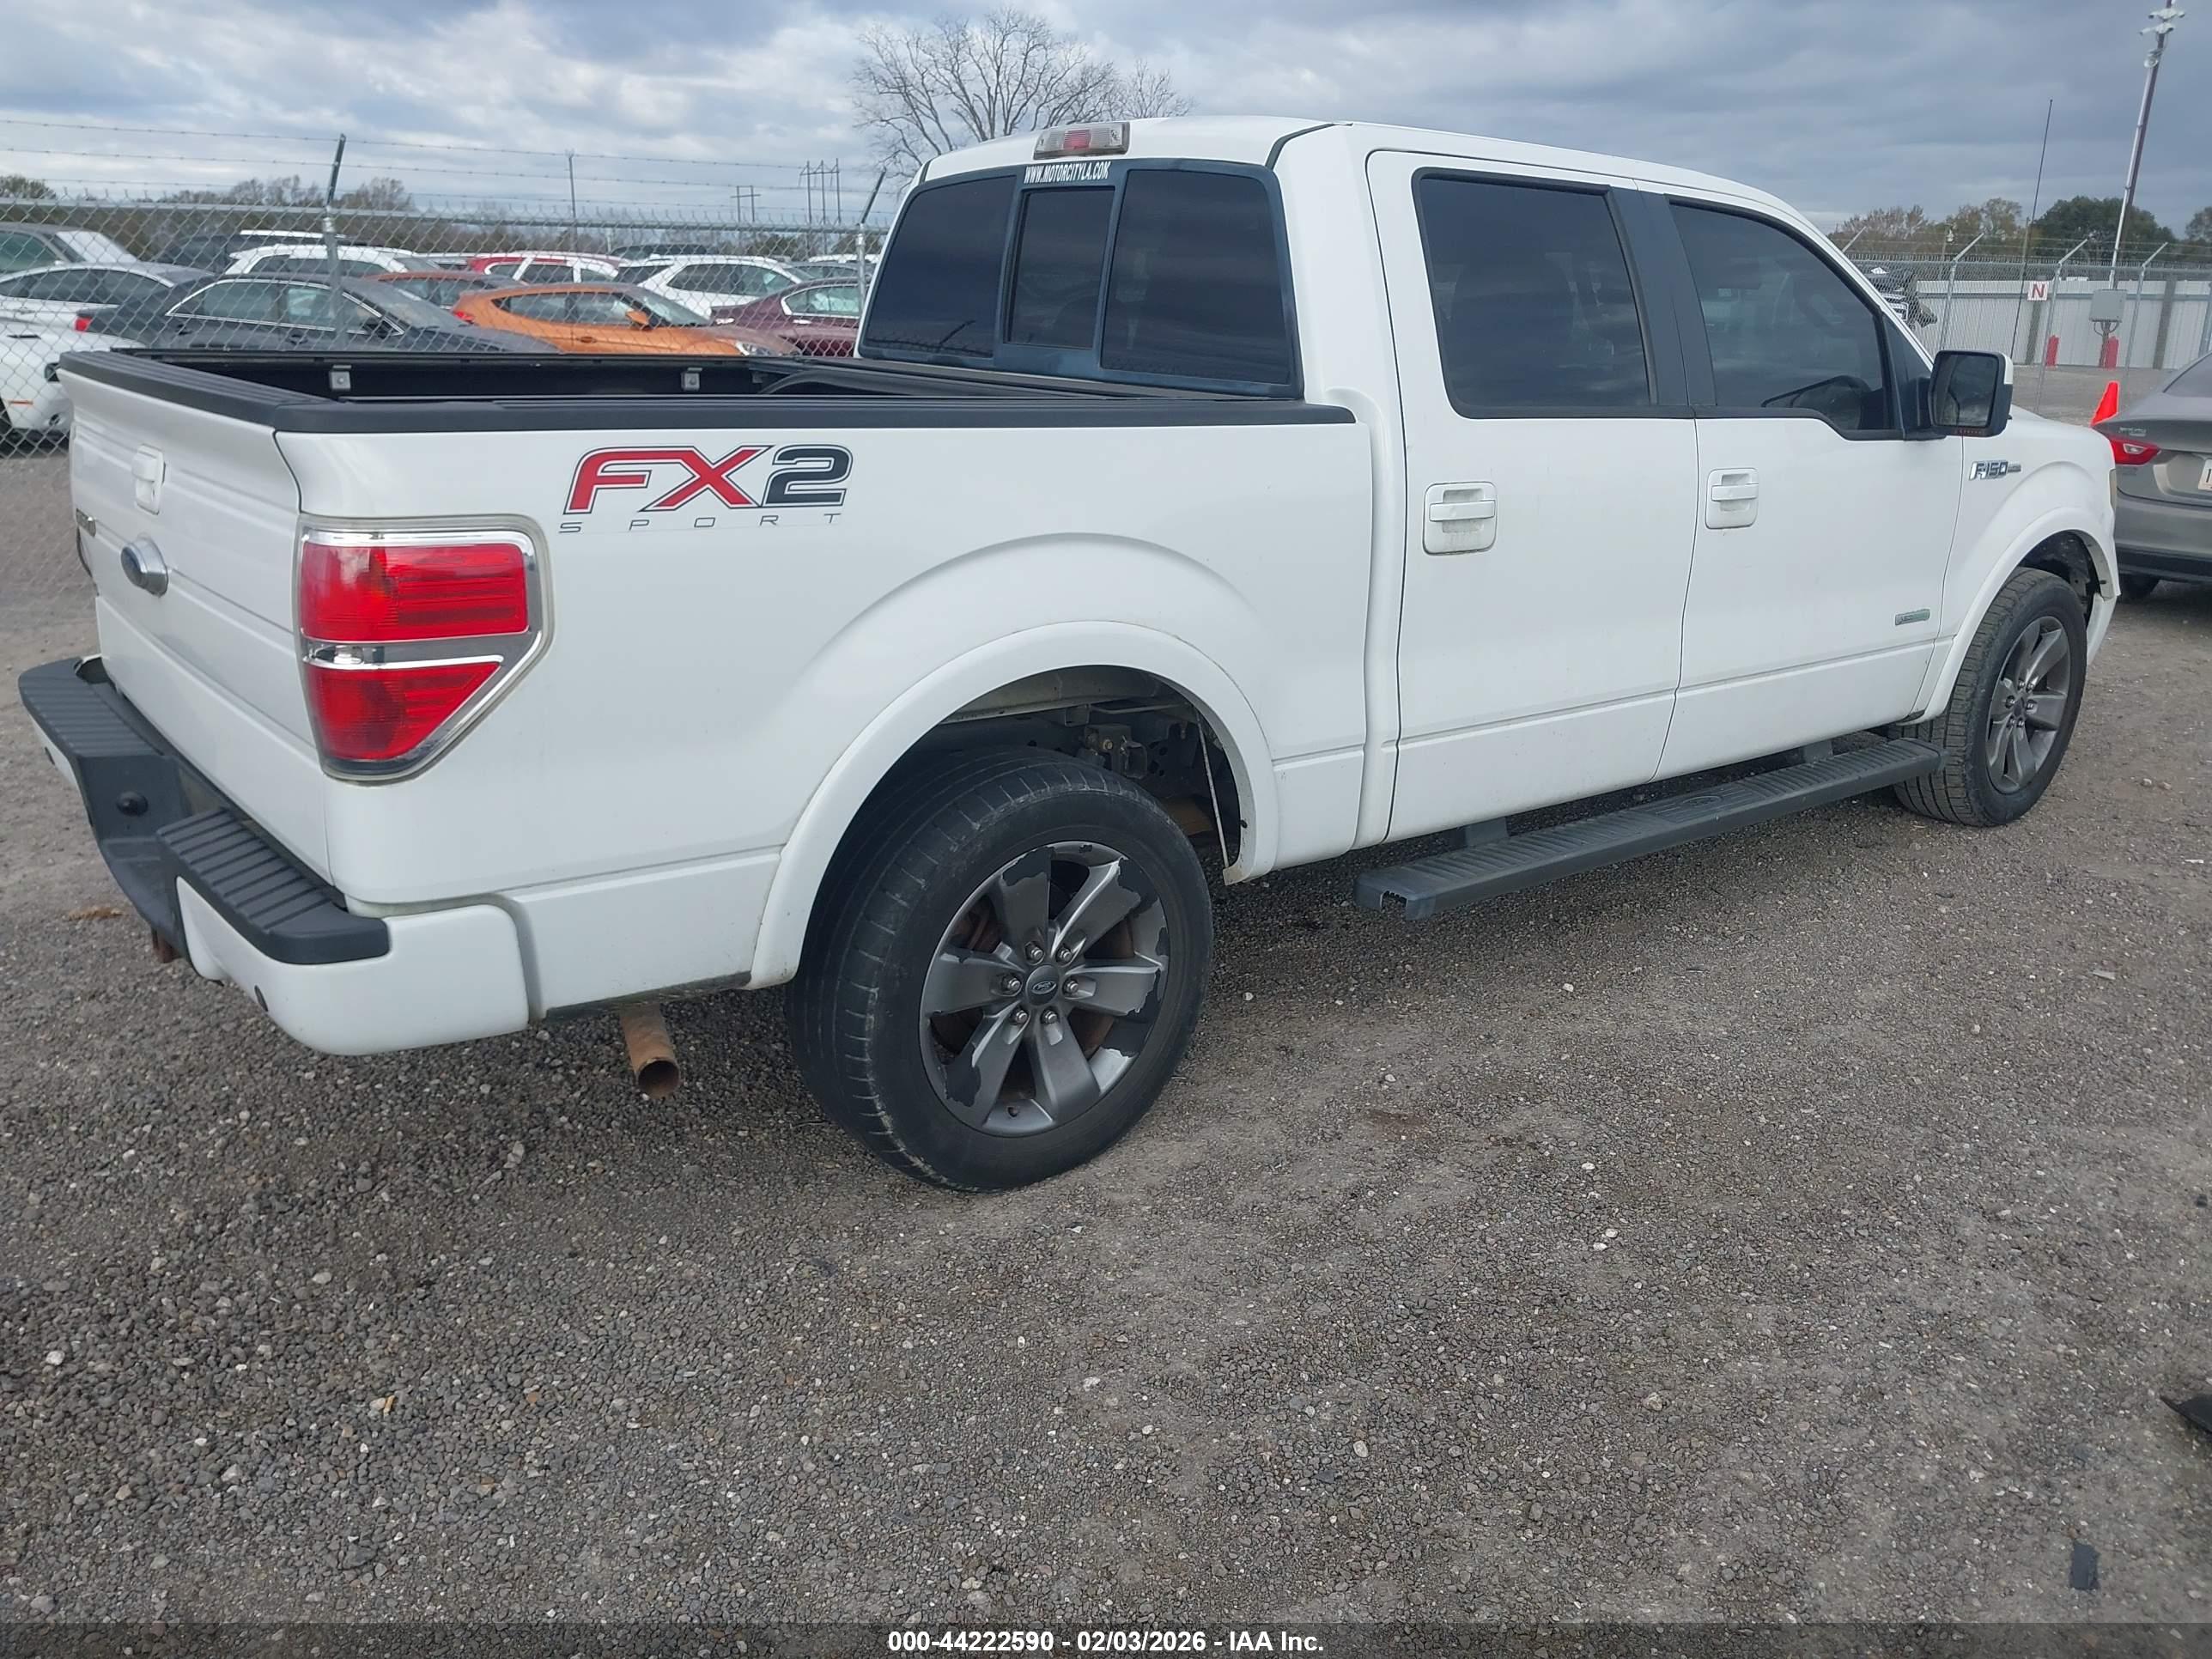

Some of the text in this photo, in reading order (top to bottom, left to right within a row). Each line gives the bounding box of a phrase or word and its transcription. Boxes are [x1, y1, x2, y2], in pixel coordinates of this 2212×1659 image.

[2032, 283, 2045, 298] N
[563, 444, 854, 515] FX2
[558, 513, 842, 534] SPORT
